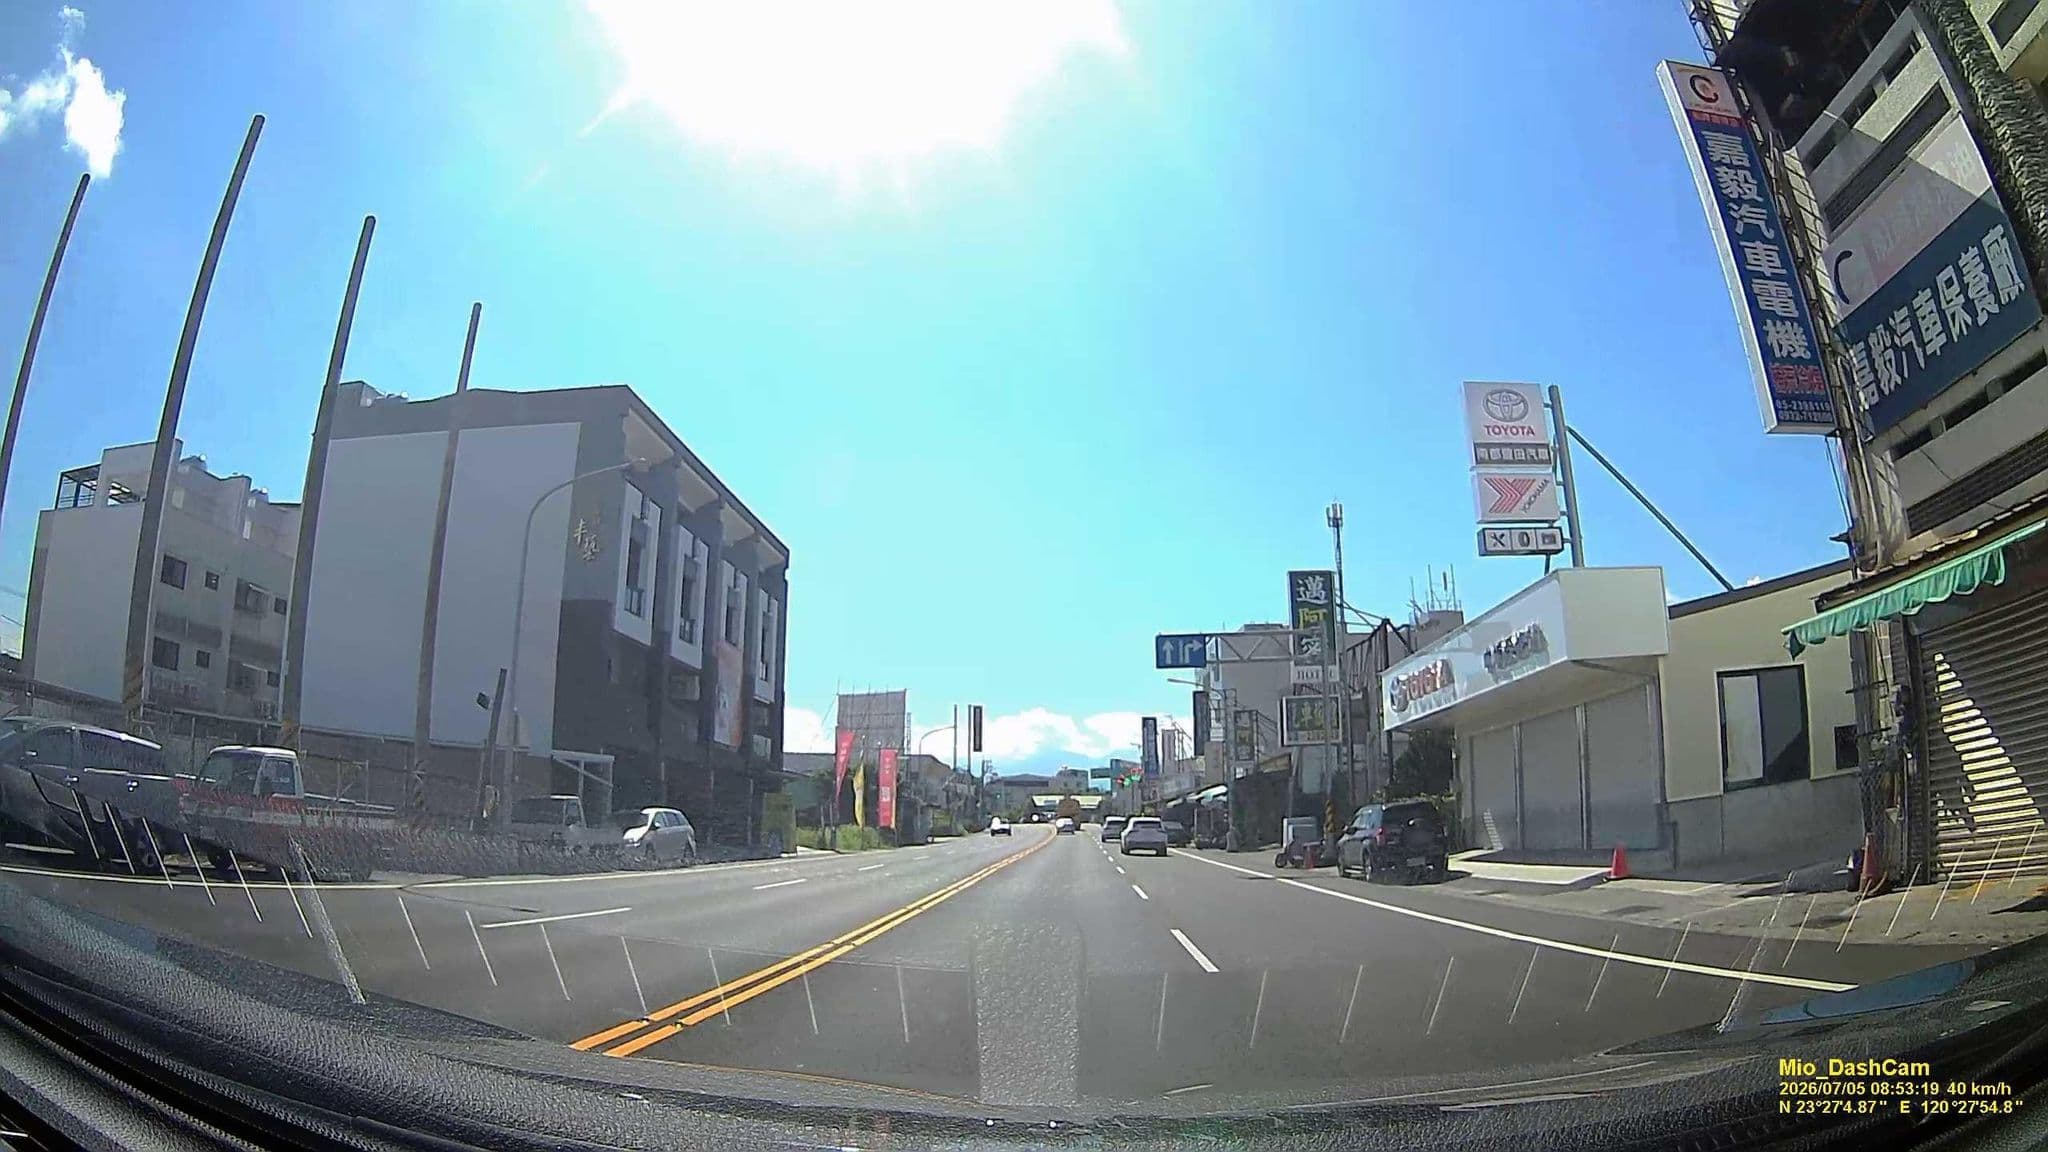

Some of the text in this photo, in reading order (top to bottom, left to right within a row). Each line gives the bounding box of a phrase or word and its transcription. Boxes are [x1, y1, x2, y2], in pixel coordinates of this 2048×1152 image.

[1701, 130, 1811, 359] 嘉毅汽車電機
[1852, 223, 2025, 412] 嘉毅汽車保養廠
[1484, 424, 1536, 437] TOYOTA
